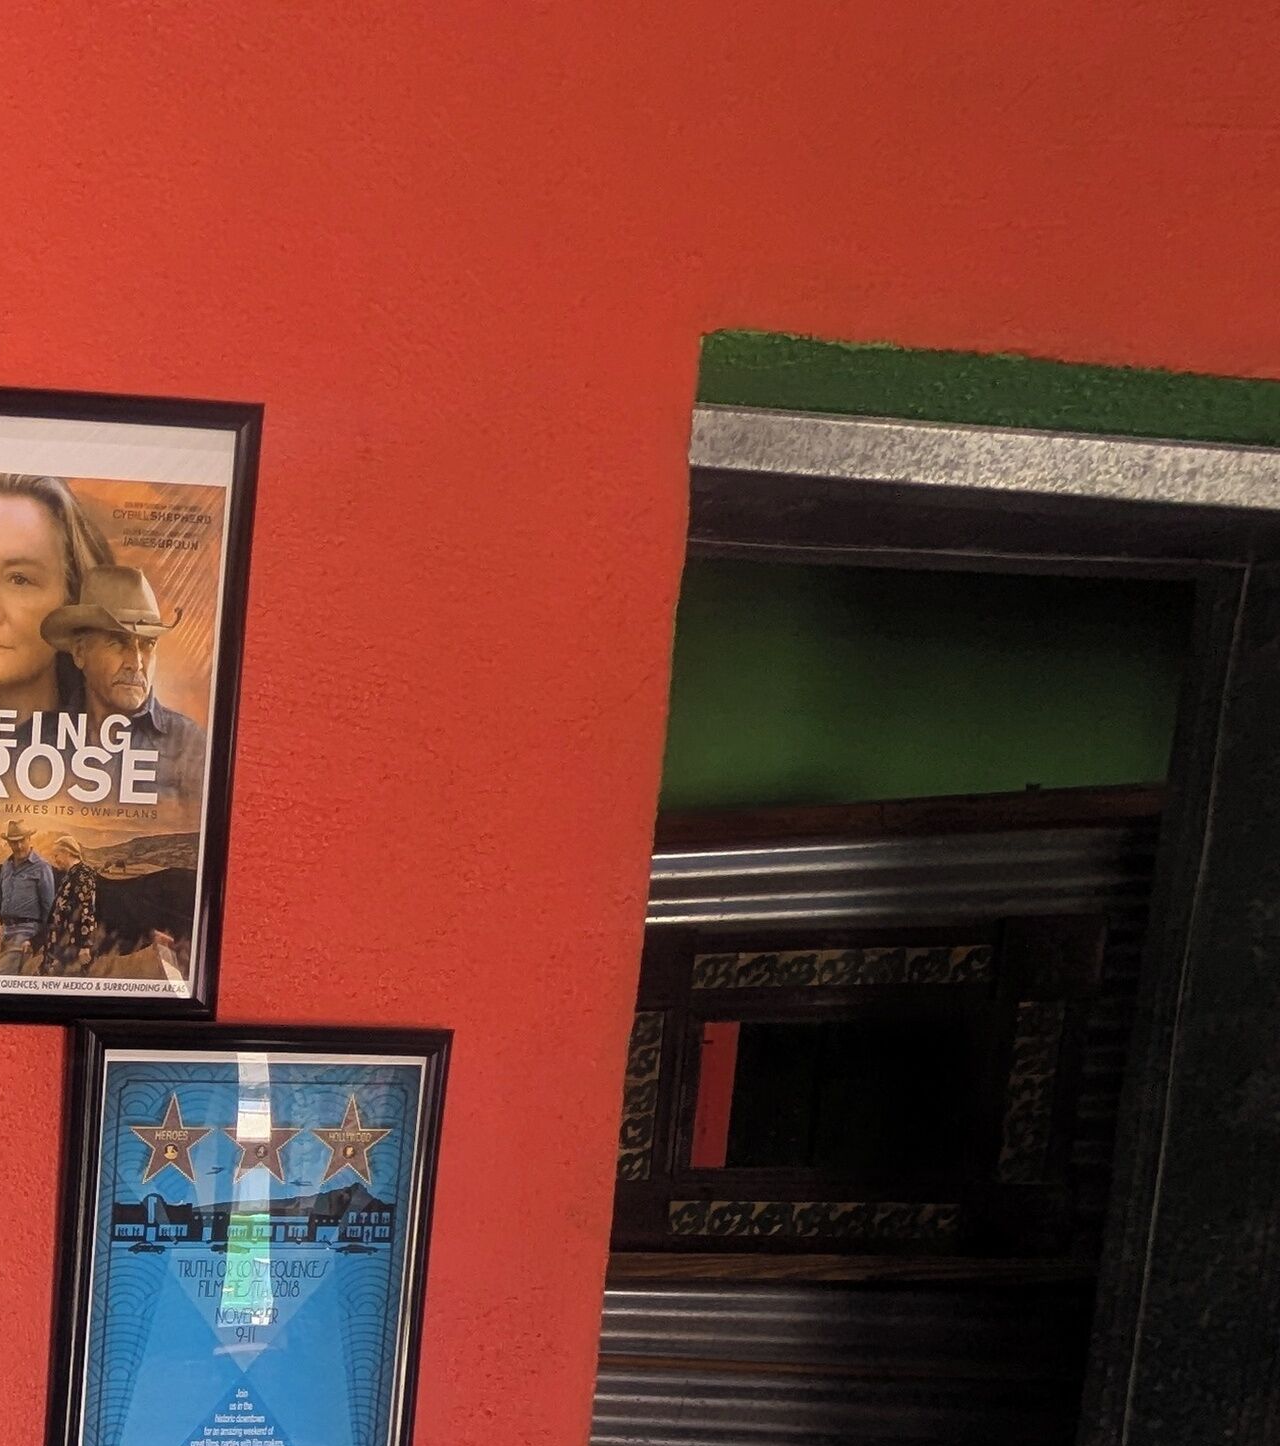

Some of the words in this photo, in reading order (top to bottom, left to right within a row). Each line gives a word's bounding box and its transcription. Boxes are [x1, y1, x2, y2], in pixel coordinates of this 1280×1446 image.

[5, 804, 48, 814] MAKES
[55, 806, 74, 815] ITS
[81, 807, 110, 817] OWN
[117, 808, 158, 819] PLANS
[42, 981, 60, 989] NEW
[63, 982, 93, 990] MEXICO
[95, 982, 100, 990] &
[102, 983, 160, 992] SURROUNDING
[162, 984, 185, 993] AREAS
[155, 1130, 188, 1141] HEROES
[329, 1132, 372, 1142] HOLLYWOOD
[177, 1260, 214, 1278] TRUTH
[216, 1260, 233, 1278] OR
[198, 1279, 224, 1298] FILM
[274, 1280, 300, 1298] 2018
[235, 1327, 256, 1343] 9-11
